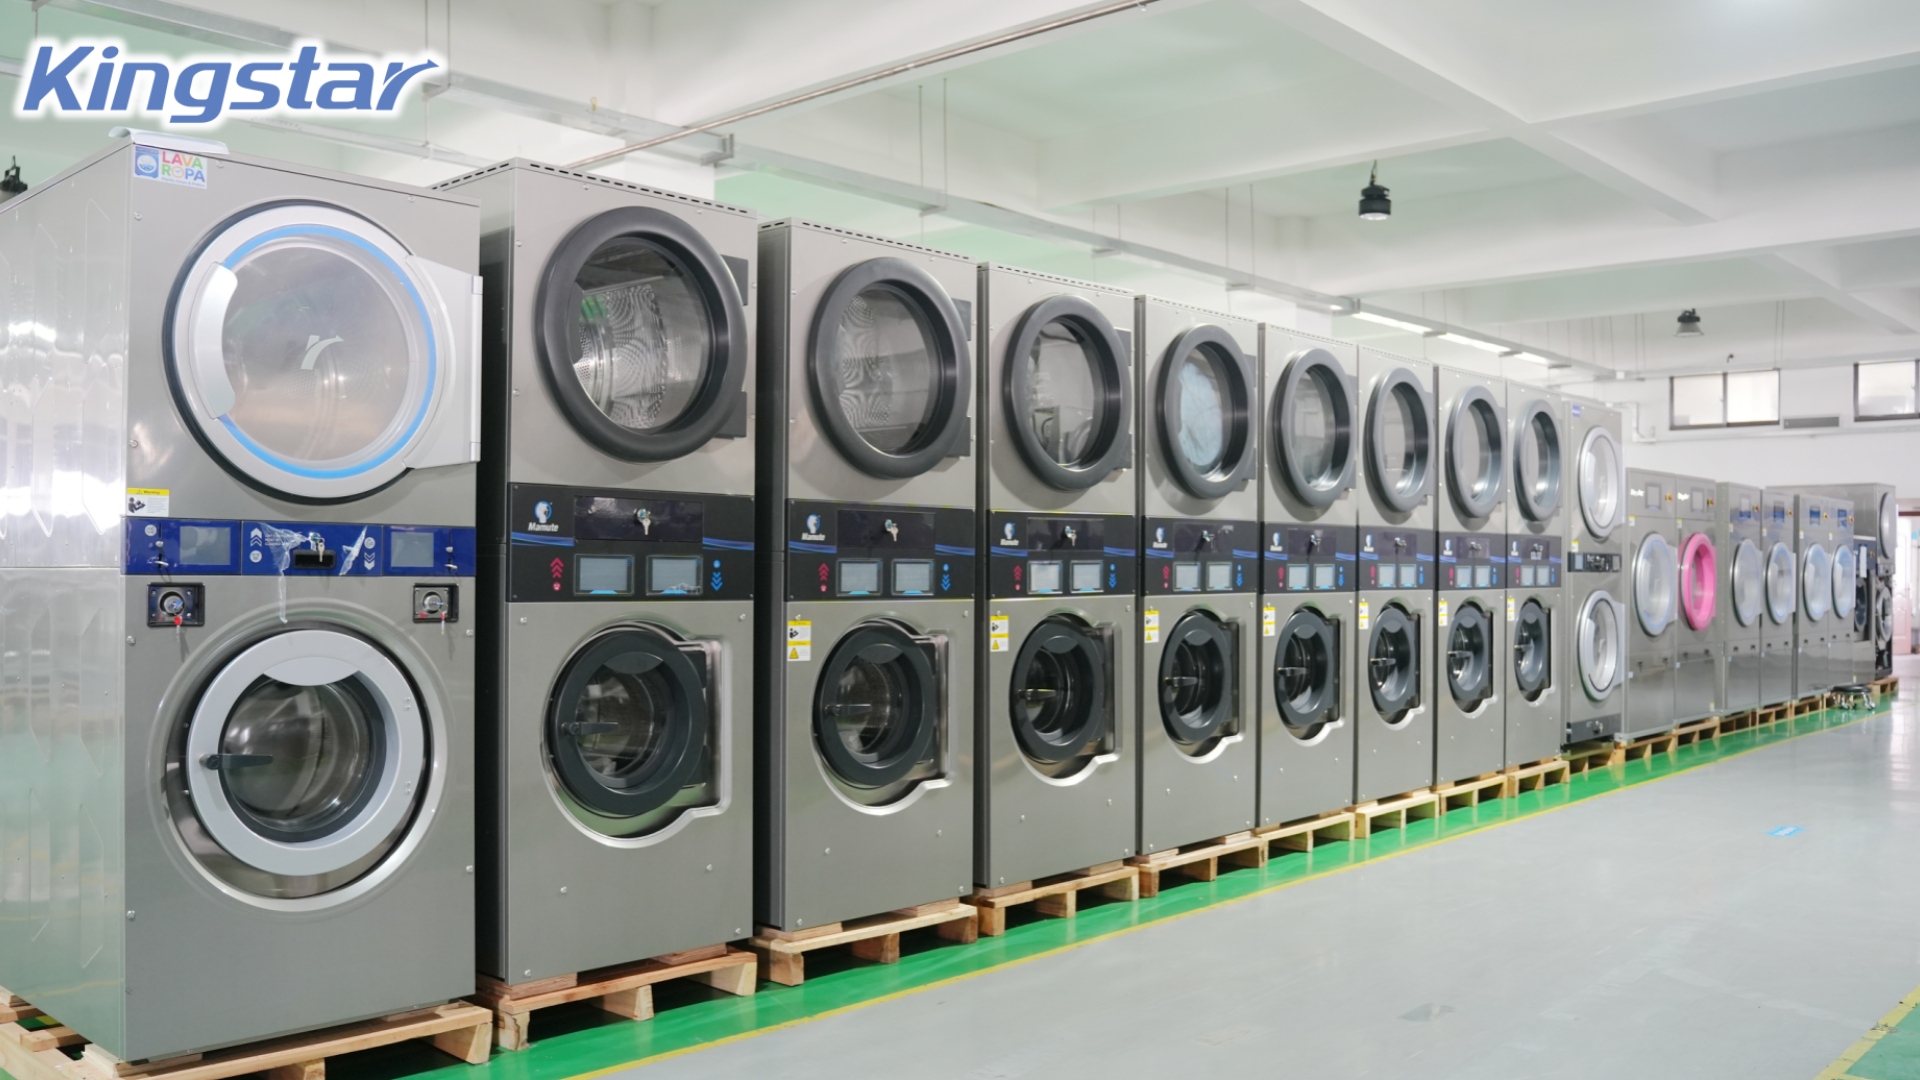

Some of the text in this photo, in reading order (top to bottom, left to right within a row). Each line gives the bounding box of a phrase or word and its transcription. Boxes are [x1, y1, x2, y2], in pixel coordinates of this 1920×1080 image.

[162, 151, 203, 170] LAVA
[161, 163, 206, 183] ROPA
[528, 522, 559, 532] Mamute
